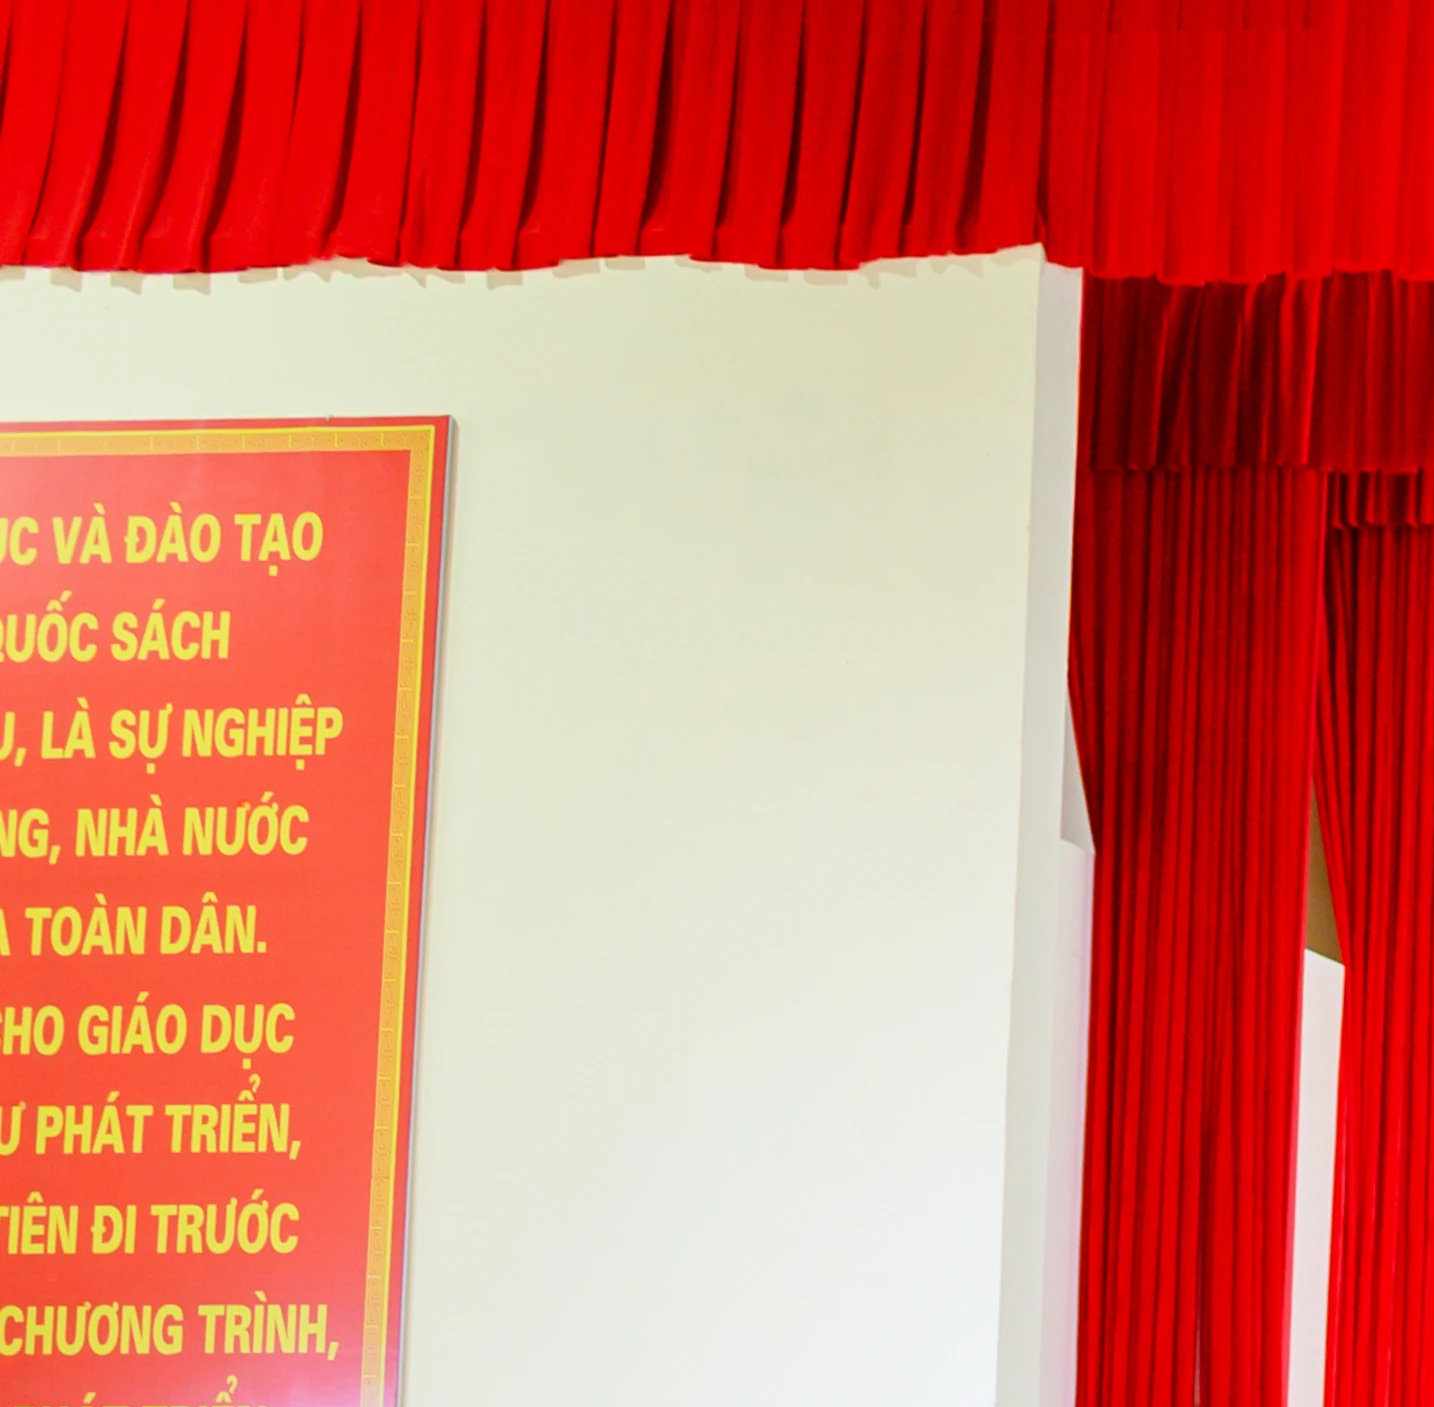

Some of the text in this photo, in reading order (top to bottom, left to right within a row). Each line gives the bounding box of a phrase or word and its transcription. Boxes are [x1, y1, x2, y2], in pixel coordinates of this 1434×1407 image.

[53, 504, 111, 564] VÀ
[124, 502, 221, 563] ĐÀO
[234, 512, 323, 576] TẠO
[0, 591, 230, 662] UỐC SÁCH
[41, 698, 95, 758] LÀ
[110, 704, 172, 773] SỰ
[183, 694, 342, 770] NGHIỆP
[76, 795, 168, 856] NHÀ
[183, 792, 308, 855] NƯỚC
[25, 894, 146, 956] TOÀN
[161, 892, 266, 954] DÂN.
[0, 992, 294, 1069] HO GIÁO DỤC
[36, 1091, 153, 1154] PHÁT
[165, 1074, 300, 1159] TRIỂN,
[91, 1205, 136, 1253] ĐI
[151, 1189, 299, 1253] TRƯỚC
[0, 1291, 338, 1360] CHƯƠNG TRÌNH,
